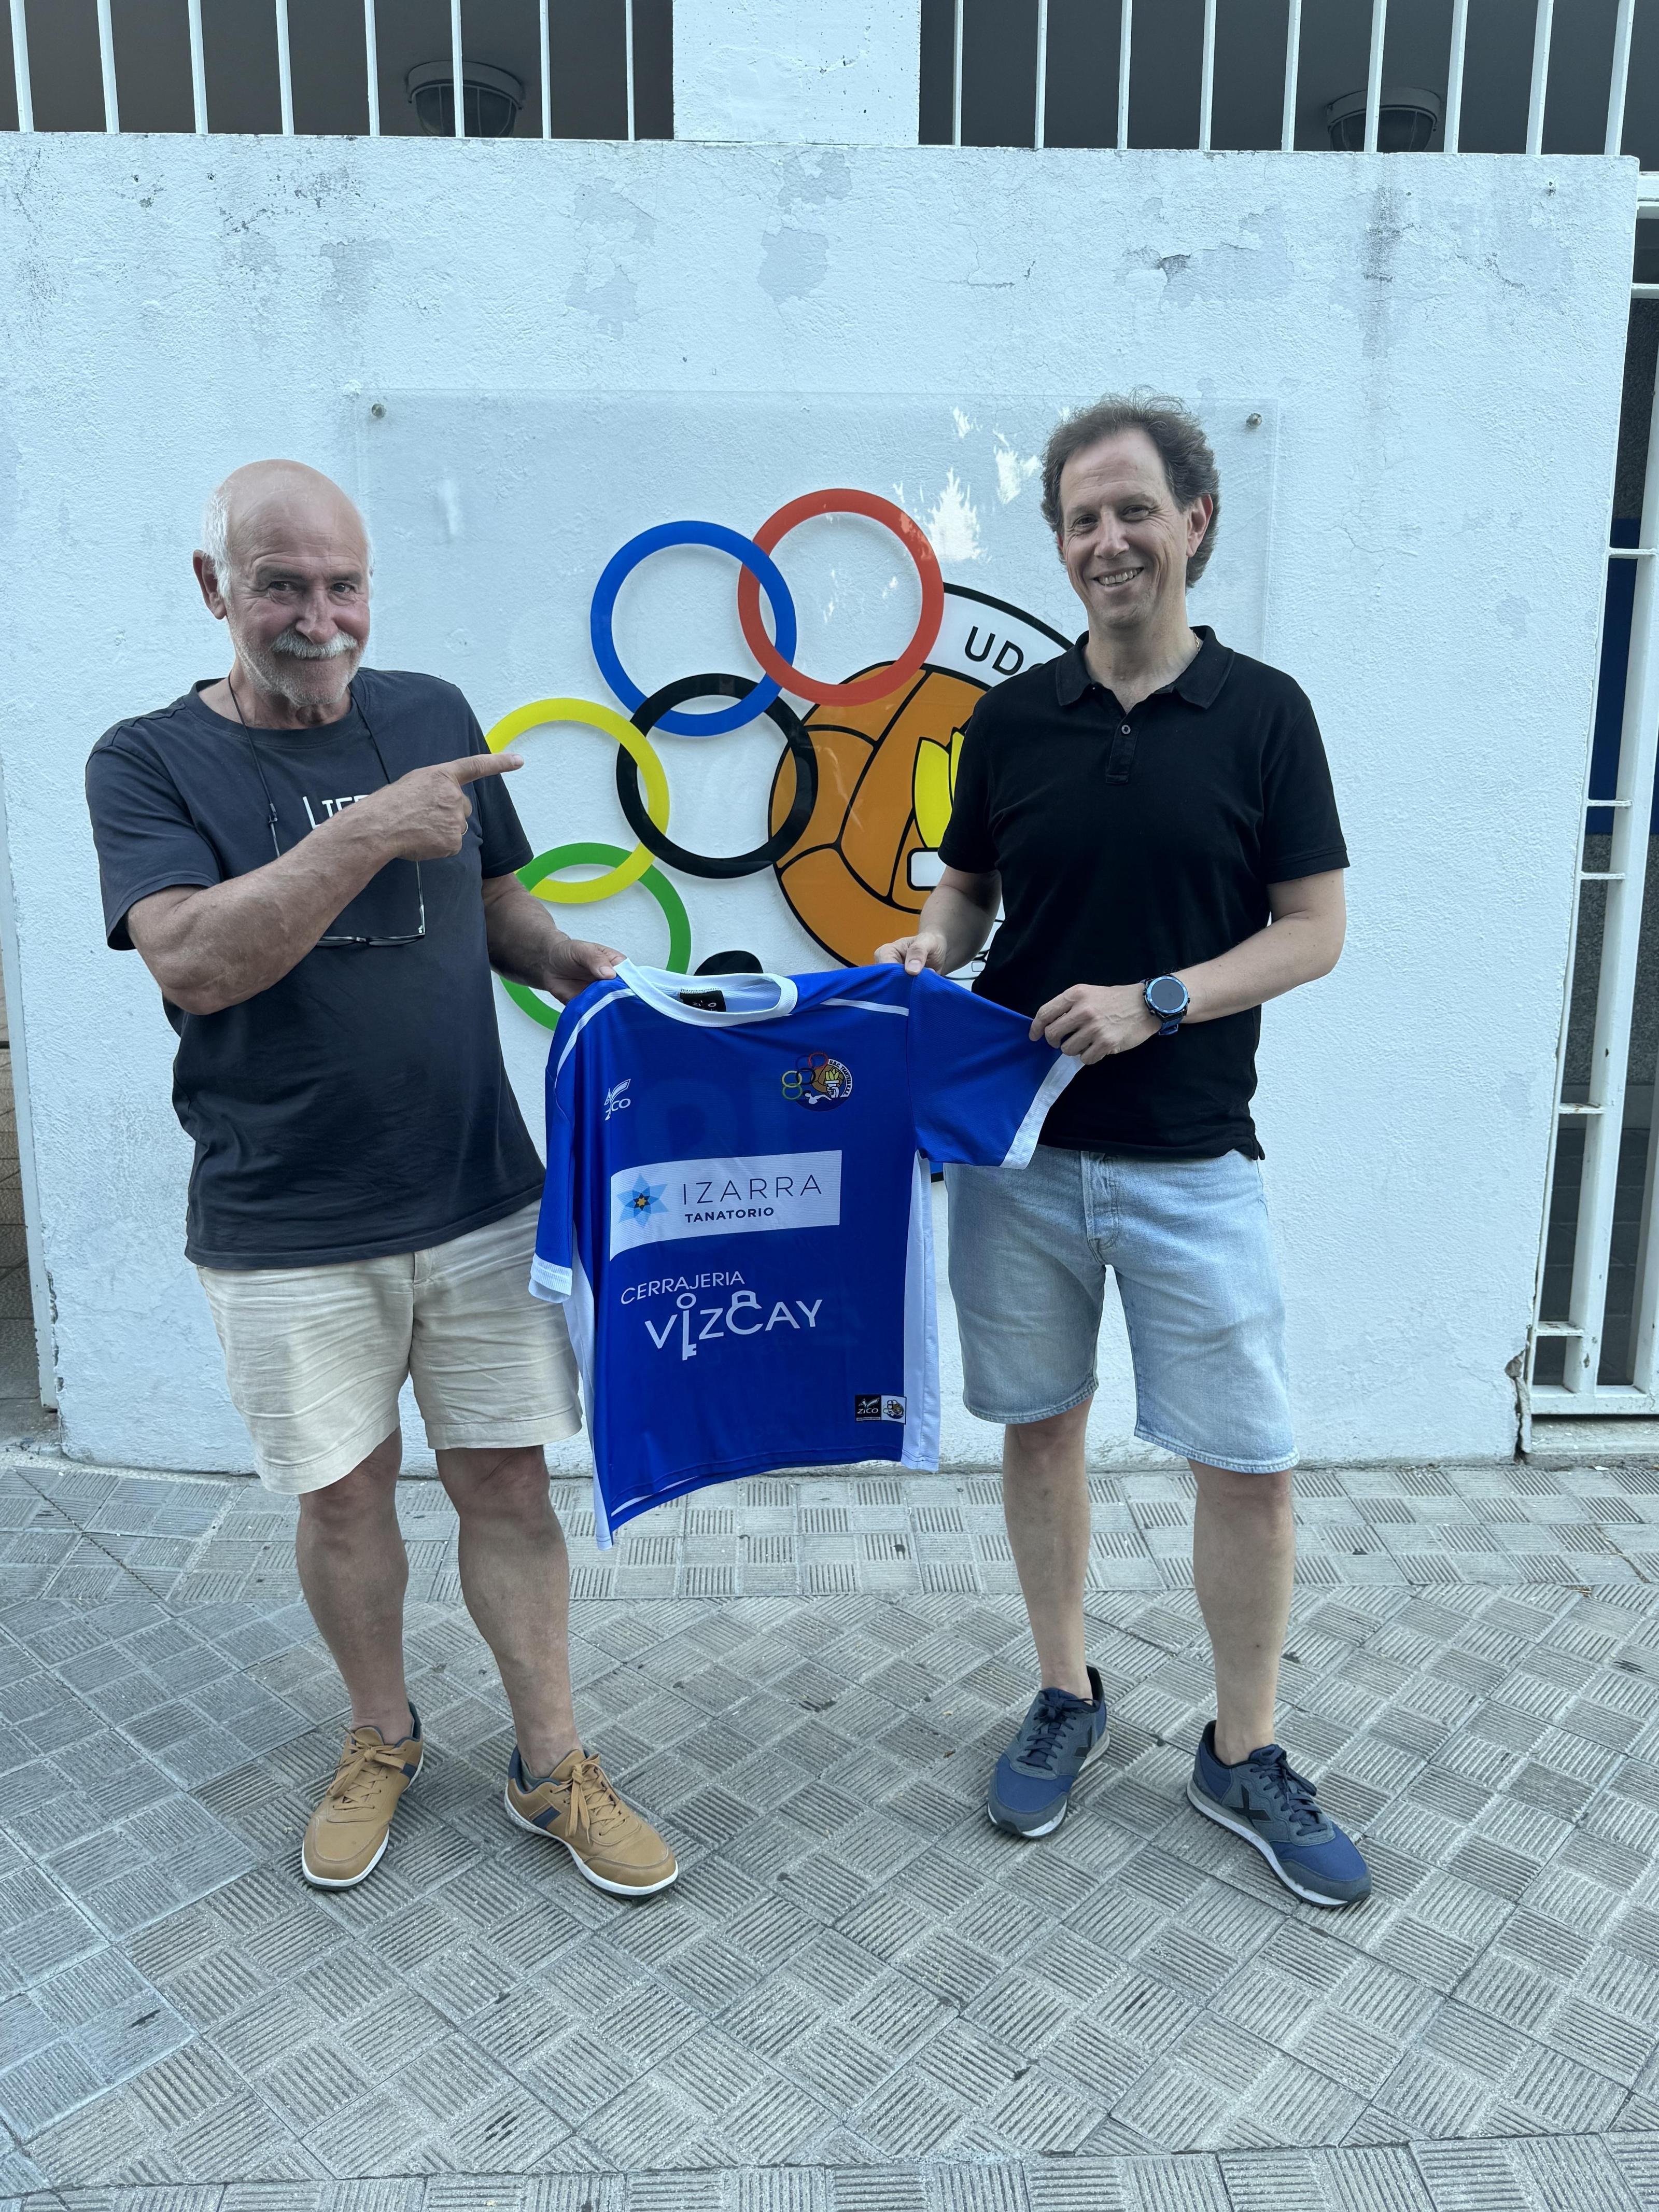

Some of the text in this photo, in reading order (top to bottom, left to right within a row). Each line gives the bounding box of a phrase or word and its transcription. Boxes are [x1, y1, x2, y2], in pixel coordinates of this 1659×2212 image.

[965, 626, 1044, 676] UD
[683, 1174, 822, 1205] IZARRA
[685, 1207, 774, 1223] TANATORIO
[621, 1271, 745, 1305] CERRAJERIA
[644, 1290, 823, 1361] VIZCAY
